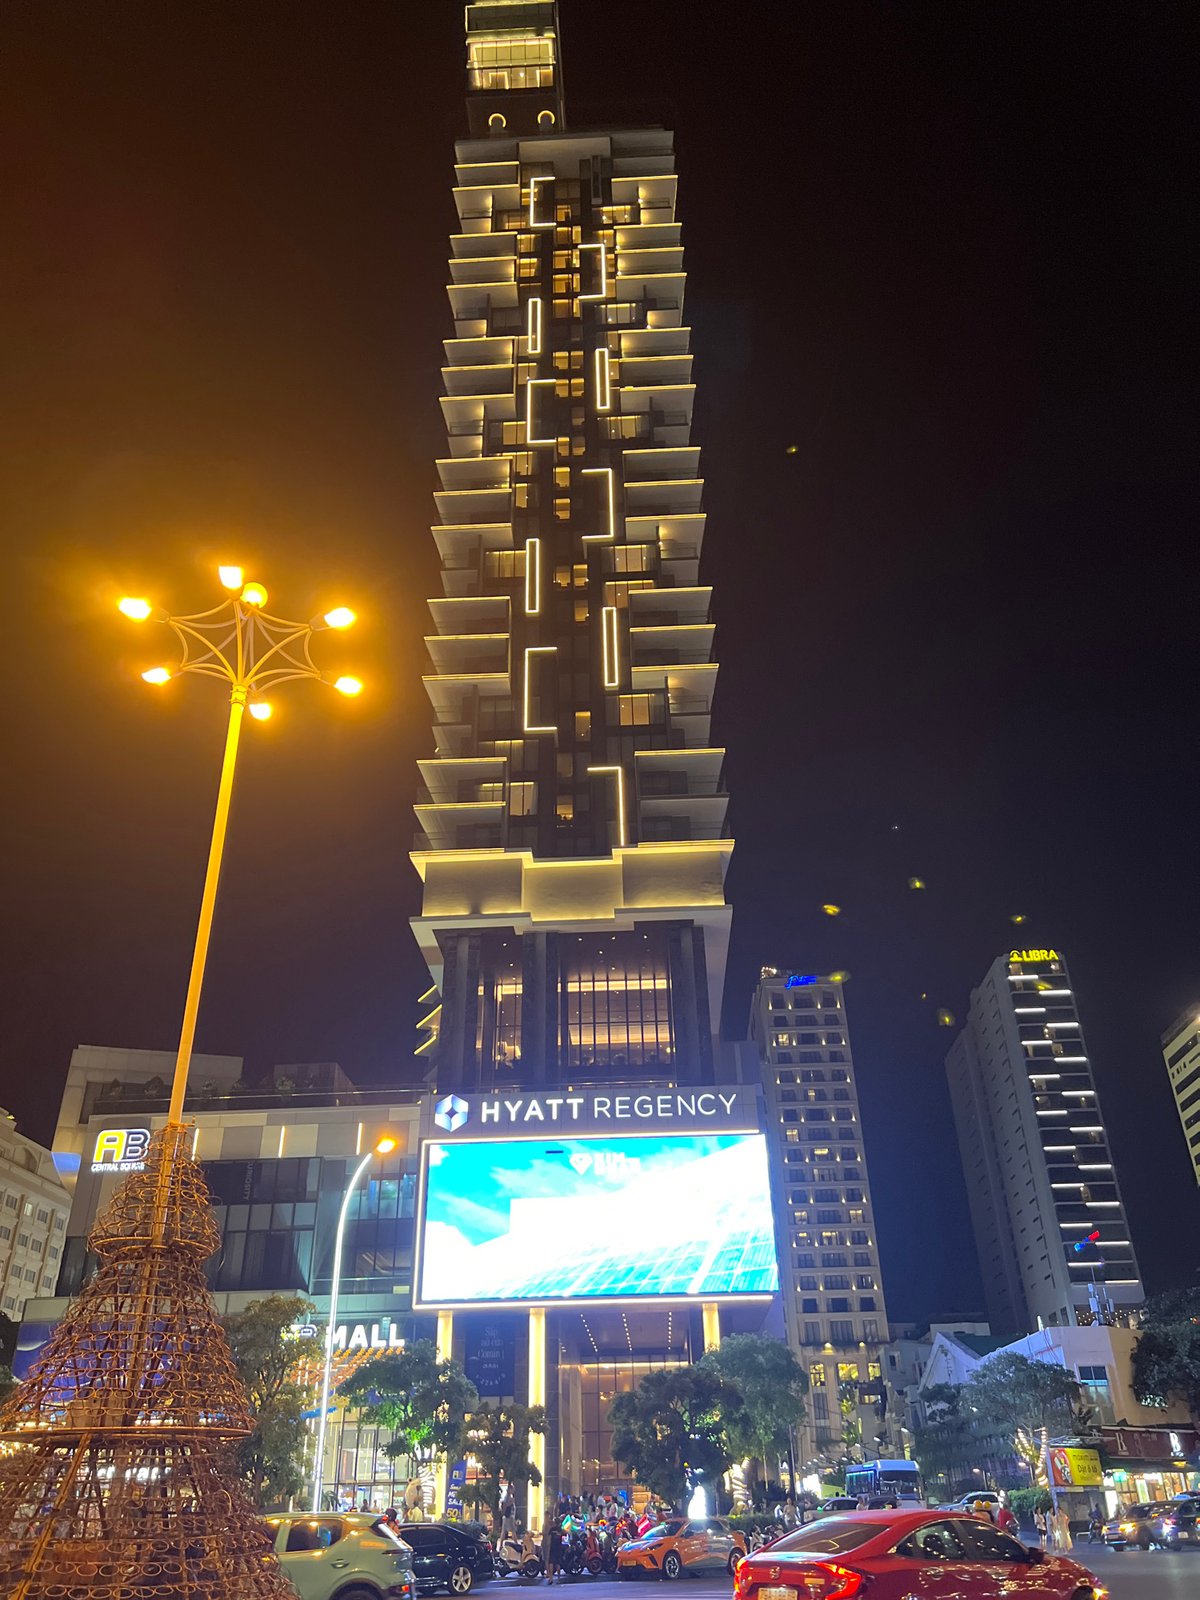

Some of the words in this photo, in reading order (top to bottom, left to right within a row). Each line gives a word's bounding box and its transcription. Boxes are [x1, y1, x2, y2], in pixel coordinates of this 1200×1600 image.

[1022, 949, 1059, 962] LIBRA
[481, 1098, 584, 1123] HYATT
[594, 1093, 736, 1118] REGENCY
[93, 1129, 150, 1162] AB
[91, 1162, 119, 1172] CENTRAL
[325, 1323, 405, 1349] MALL
